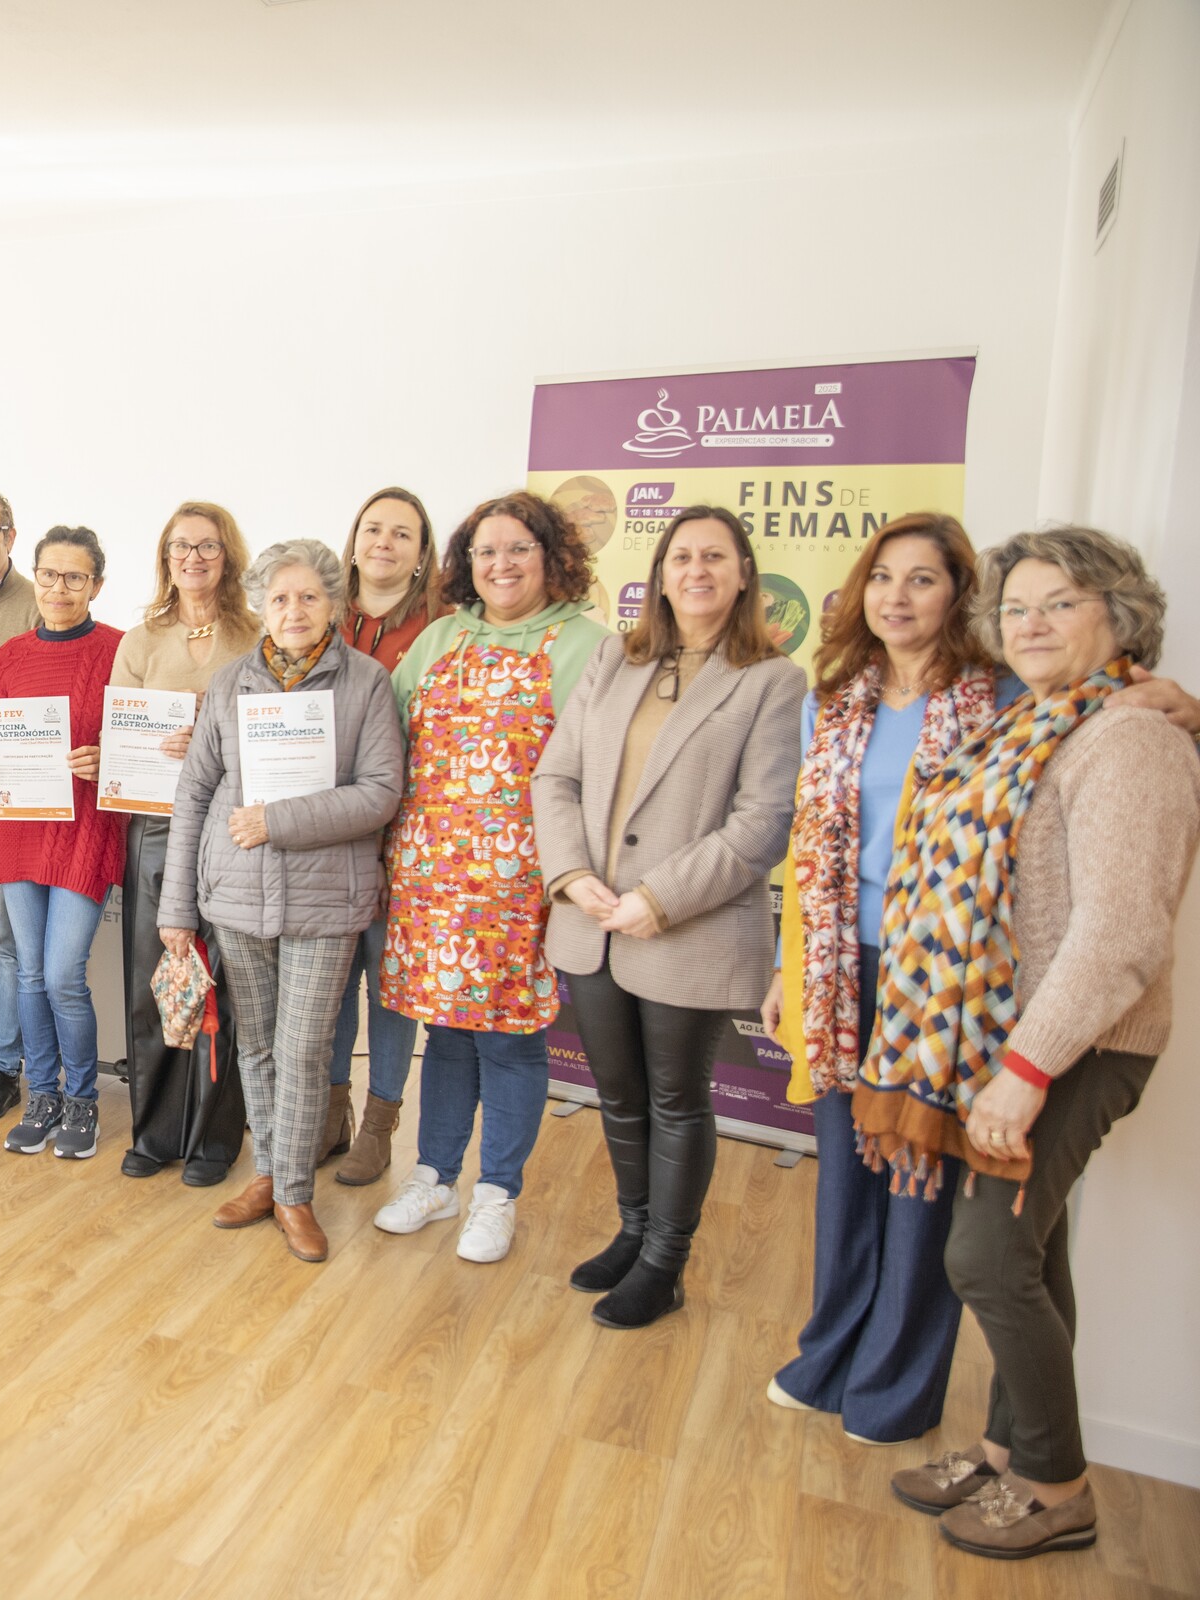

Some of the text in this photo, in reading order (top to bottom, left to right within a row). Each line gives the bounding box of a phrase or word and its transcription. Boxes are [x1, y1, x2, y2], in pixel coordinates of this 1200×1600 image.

[818, 385, 838, 393] 2025
[696, 399, 845, 433] PALMELA
[715, 437, 766, 445] EXPERIÊNCIAS
[769, 436, 788, 444] COM
[631, 487, 663, 503] JAN.
[739, 480, 871, 507] FINS DE
[629, 508, 639, 516] 17
[642, 508, 651, 516] 18
[654, 508, 663, 516] 19
[624, 520, 667, 533] FOGA
[737, 512, 888, 538] SEMAN
[755, 543, 862, 552] ASTRONÓM
[625, 586, 645, 599] AB
[127, 700, 148, 708] FEV.
[4, 710, 24, 718] FEV.
[247, 707, 259, 716] 22
[111, 712, 149, 721] OFICINA
[247, 722, 285, 730] OFICINA
[247, 728, 325, 738] GASTRONÓMICA
[547, 1058, 563, 1066] EITO
[569, 1062, 590, 1071] ALTER
